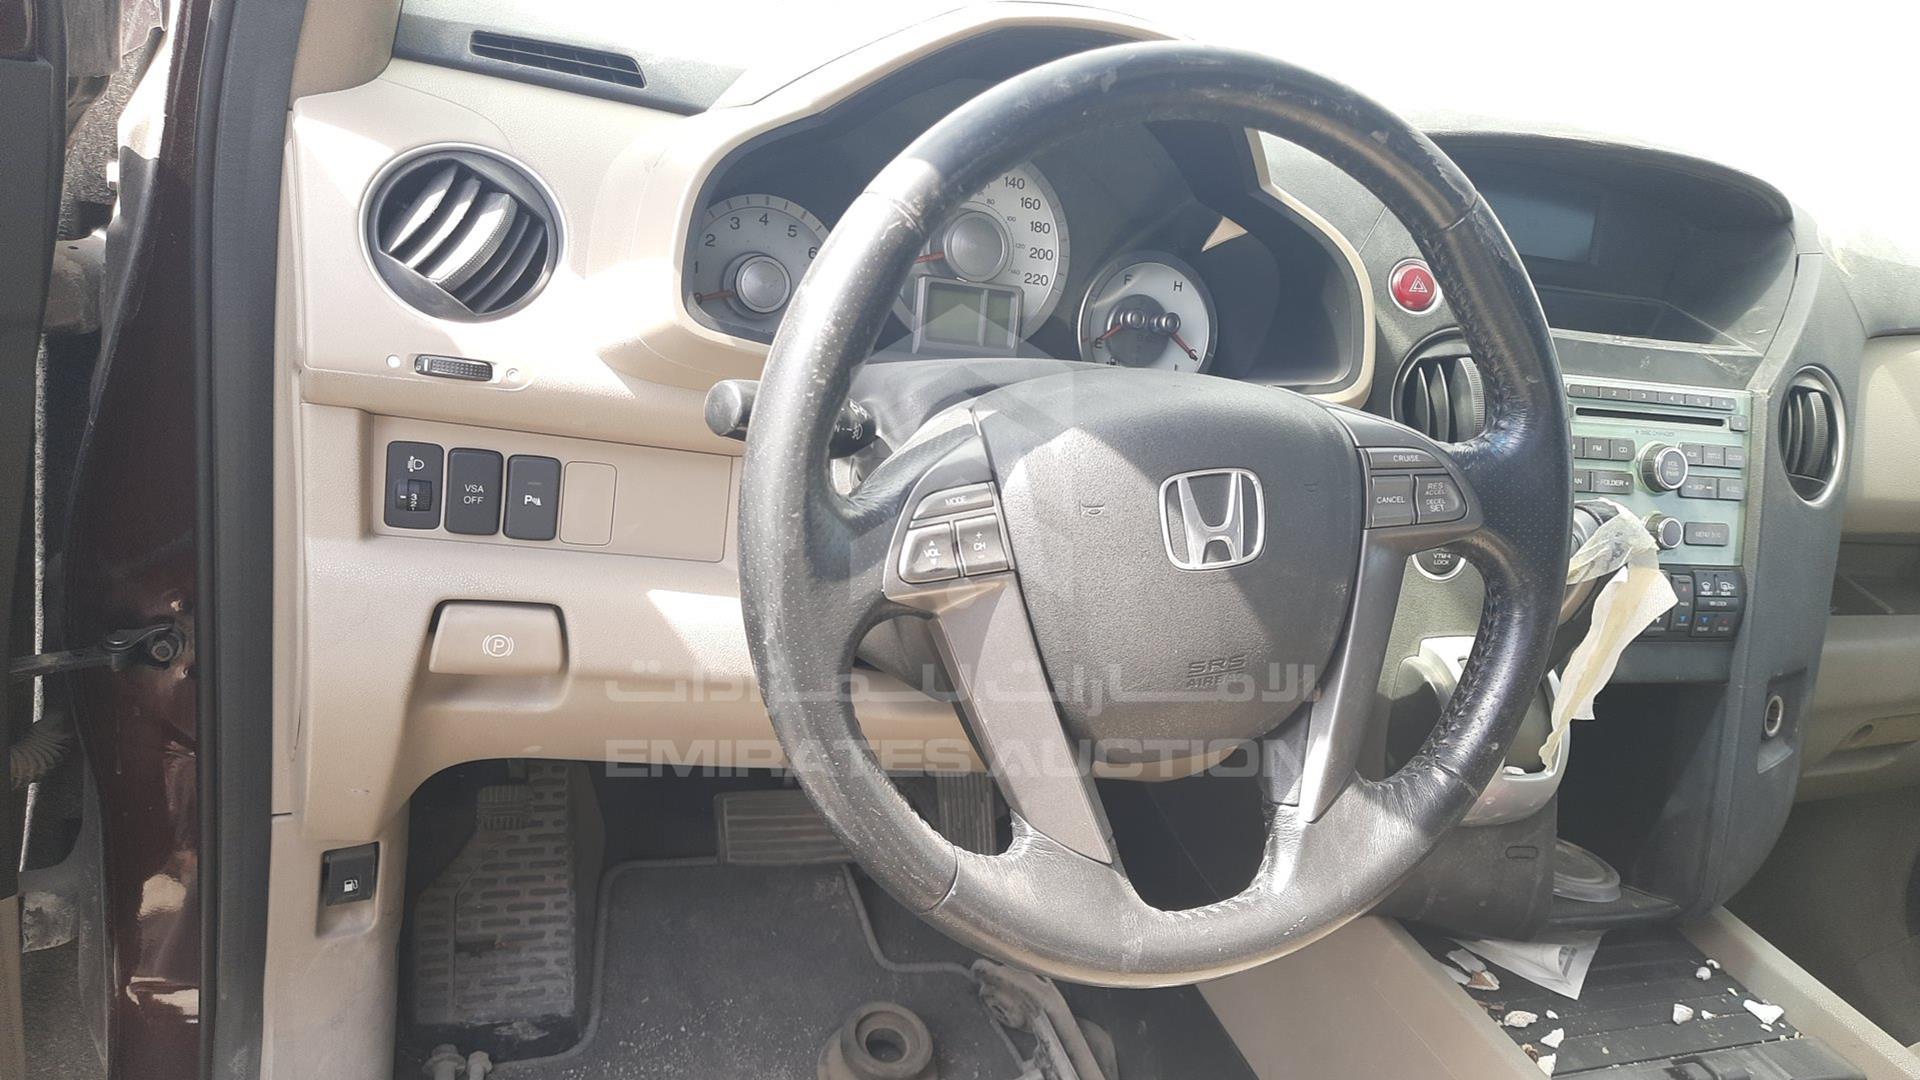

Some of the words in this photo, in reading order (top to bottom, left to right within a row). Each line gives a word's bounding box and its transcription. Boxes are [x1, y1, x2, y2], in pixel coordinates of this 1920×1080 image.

[1004, 176, 1025, 190] 140
[1020, 197, 1041, 210] 160
[730, 216, 741, 230] 3
[759, 213, 769, 226] 4
[787, 225, 798, 238] 5
[1030, 221, 1051, 234] 180
[704, 234, 716, 247] 2
[808, 246, 818, 260] 6
[1029, 247, 1054, 261] 200
[1024, 272, 1049, 286] 220
[1123, 274, 1133, 285] F
[1173, 280, 1183, 292] H
[464, 484, 485, 494] VSA
[1427, 482, 1444, 490] RES
[410, 493, 419, 502] 3
[463, 495, 484, 505] OFF
[945, 495, 967, 505] MODE
[1376, 496, 1406, 504] CANCEL
[1430, 504, 1445, 512] SET
[973, 541, 986, 551] CH
[923, 549, 941, 557] VOL
[1188, 654, 1248, 674] SRS
